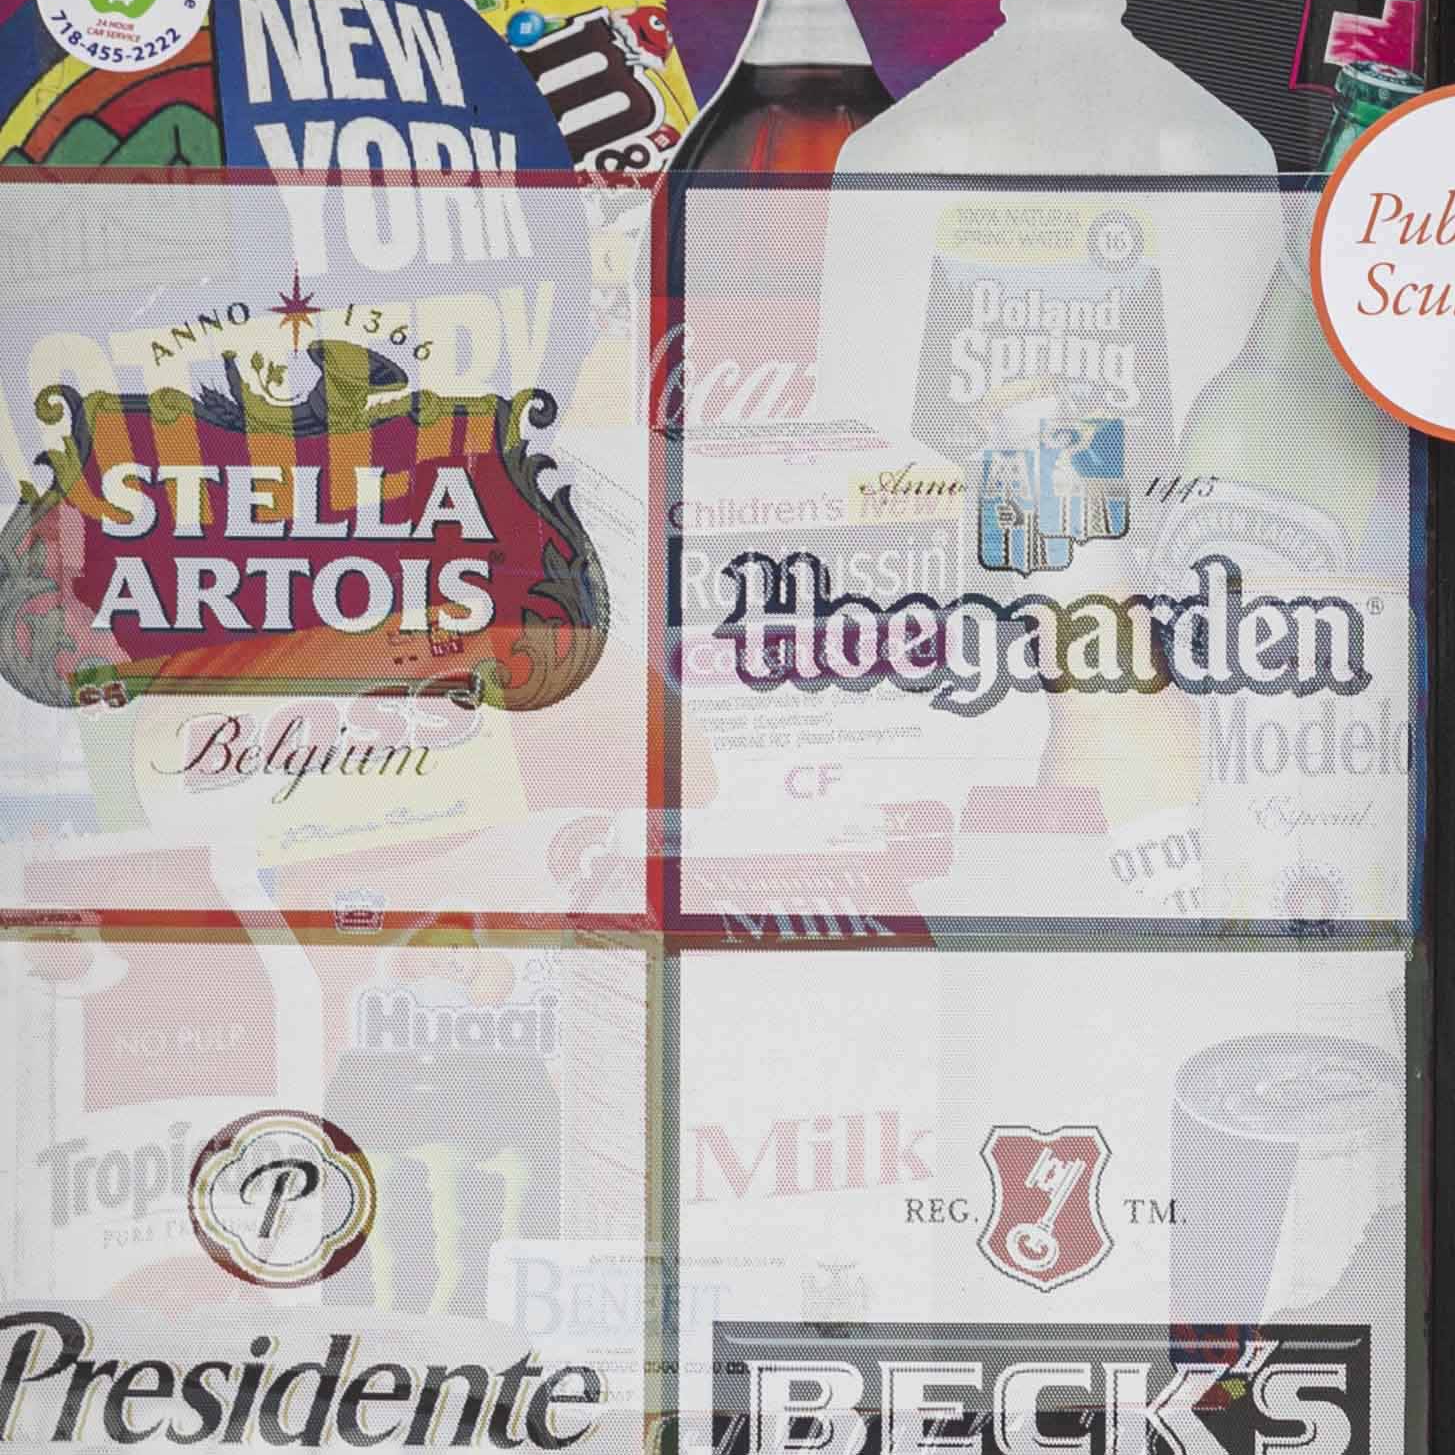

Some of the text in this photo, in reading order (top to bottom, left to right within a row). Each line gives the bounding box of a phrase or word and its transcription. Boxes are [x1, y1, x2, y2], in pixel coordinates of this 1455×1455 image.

[51, 9, 182, 63] 718-455-2222
[254, 114, 536, 276] YORK
[151, 301, 434, 365] ANNO 1366
[973, 278, 1121, 335] Poland
[948, 329, 1137, 407] Spring
[101, 462, 496, 540] STELLA
[858, 461, 1221, 507] Anno 1445
[91, 555, 494, 634] ARTOIS
[712, 551, 1372, 717] Hoegaarden
[151, 713, 440, 804] Belgium
[685, 1107, 935, 1207] Milk
[239, 1156, 322, 1239] P
[904, 1197, 1188, 1227] REG. TM.
[0, 1309, 608, 1451] Presidente
[742, 1339, 1356, 1455] BECK'S
